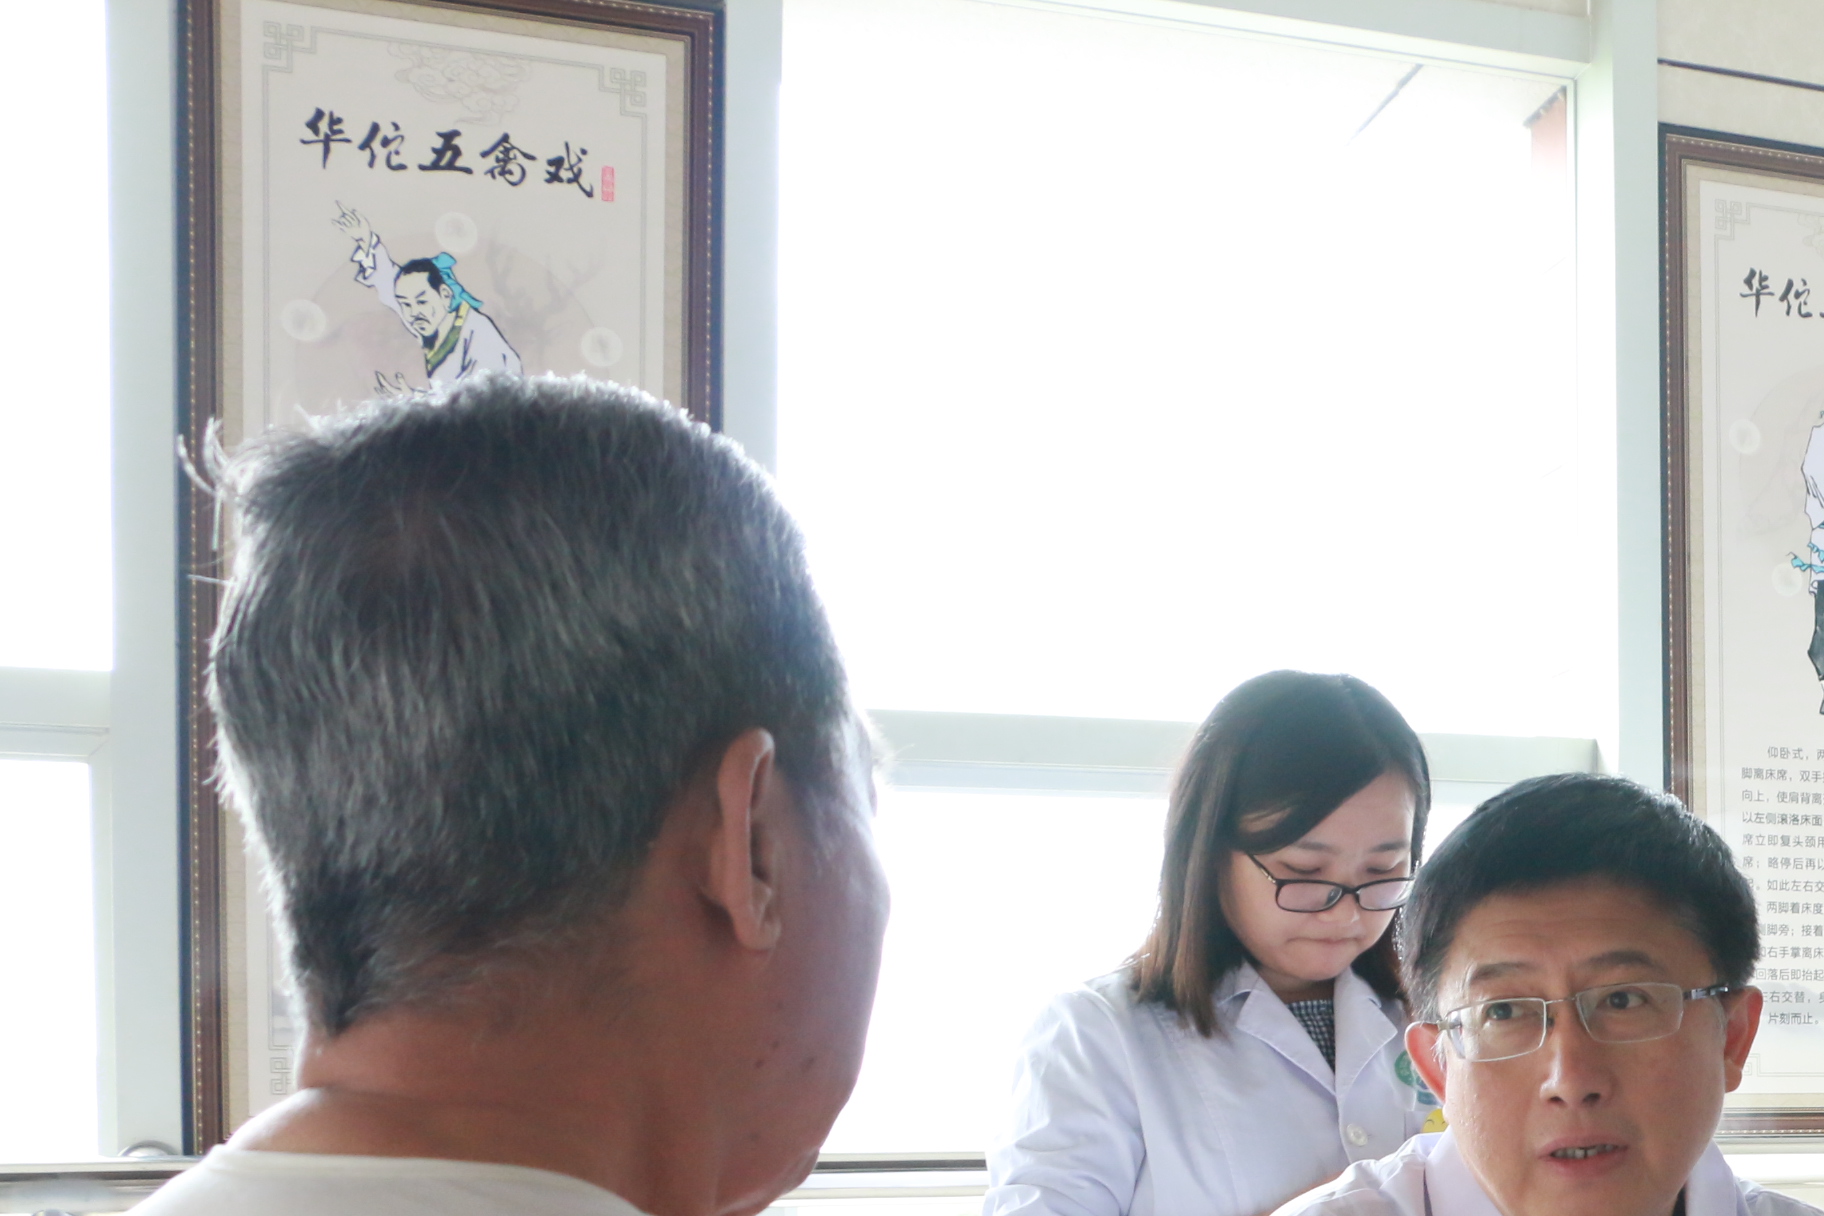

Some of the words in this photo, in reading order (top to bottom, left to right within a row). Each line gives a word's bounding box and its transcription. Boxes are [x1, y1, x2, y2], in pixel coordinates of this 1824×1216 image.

[299, 106, 594, 199] 华佗五禽戏
[1767, 1012, 1820, 1025] 片刻而止。
